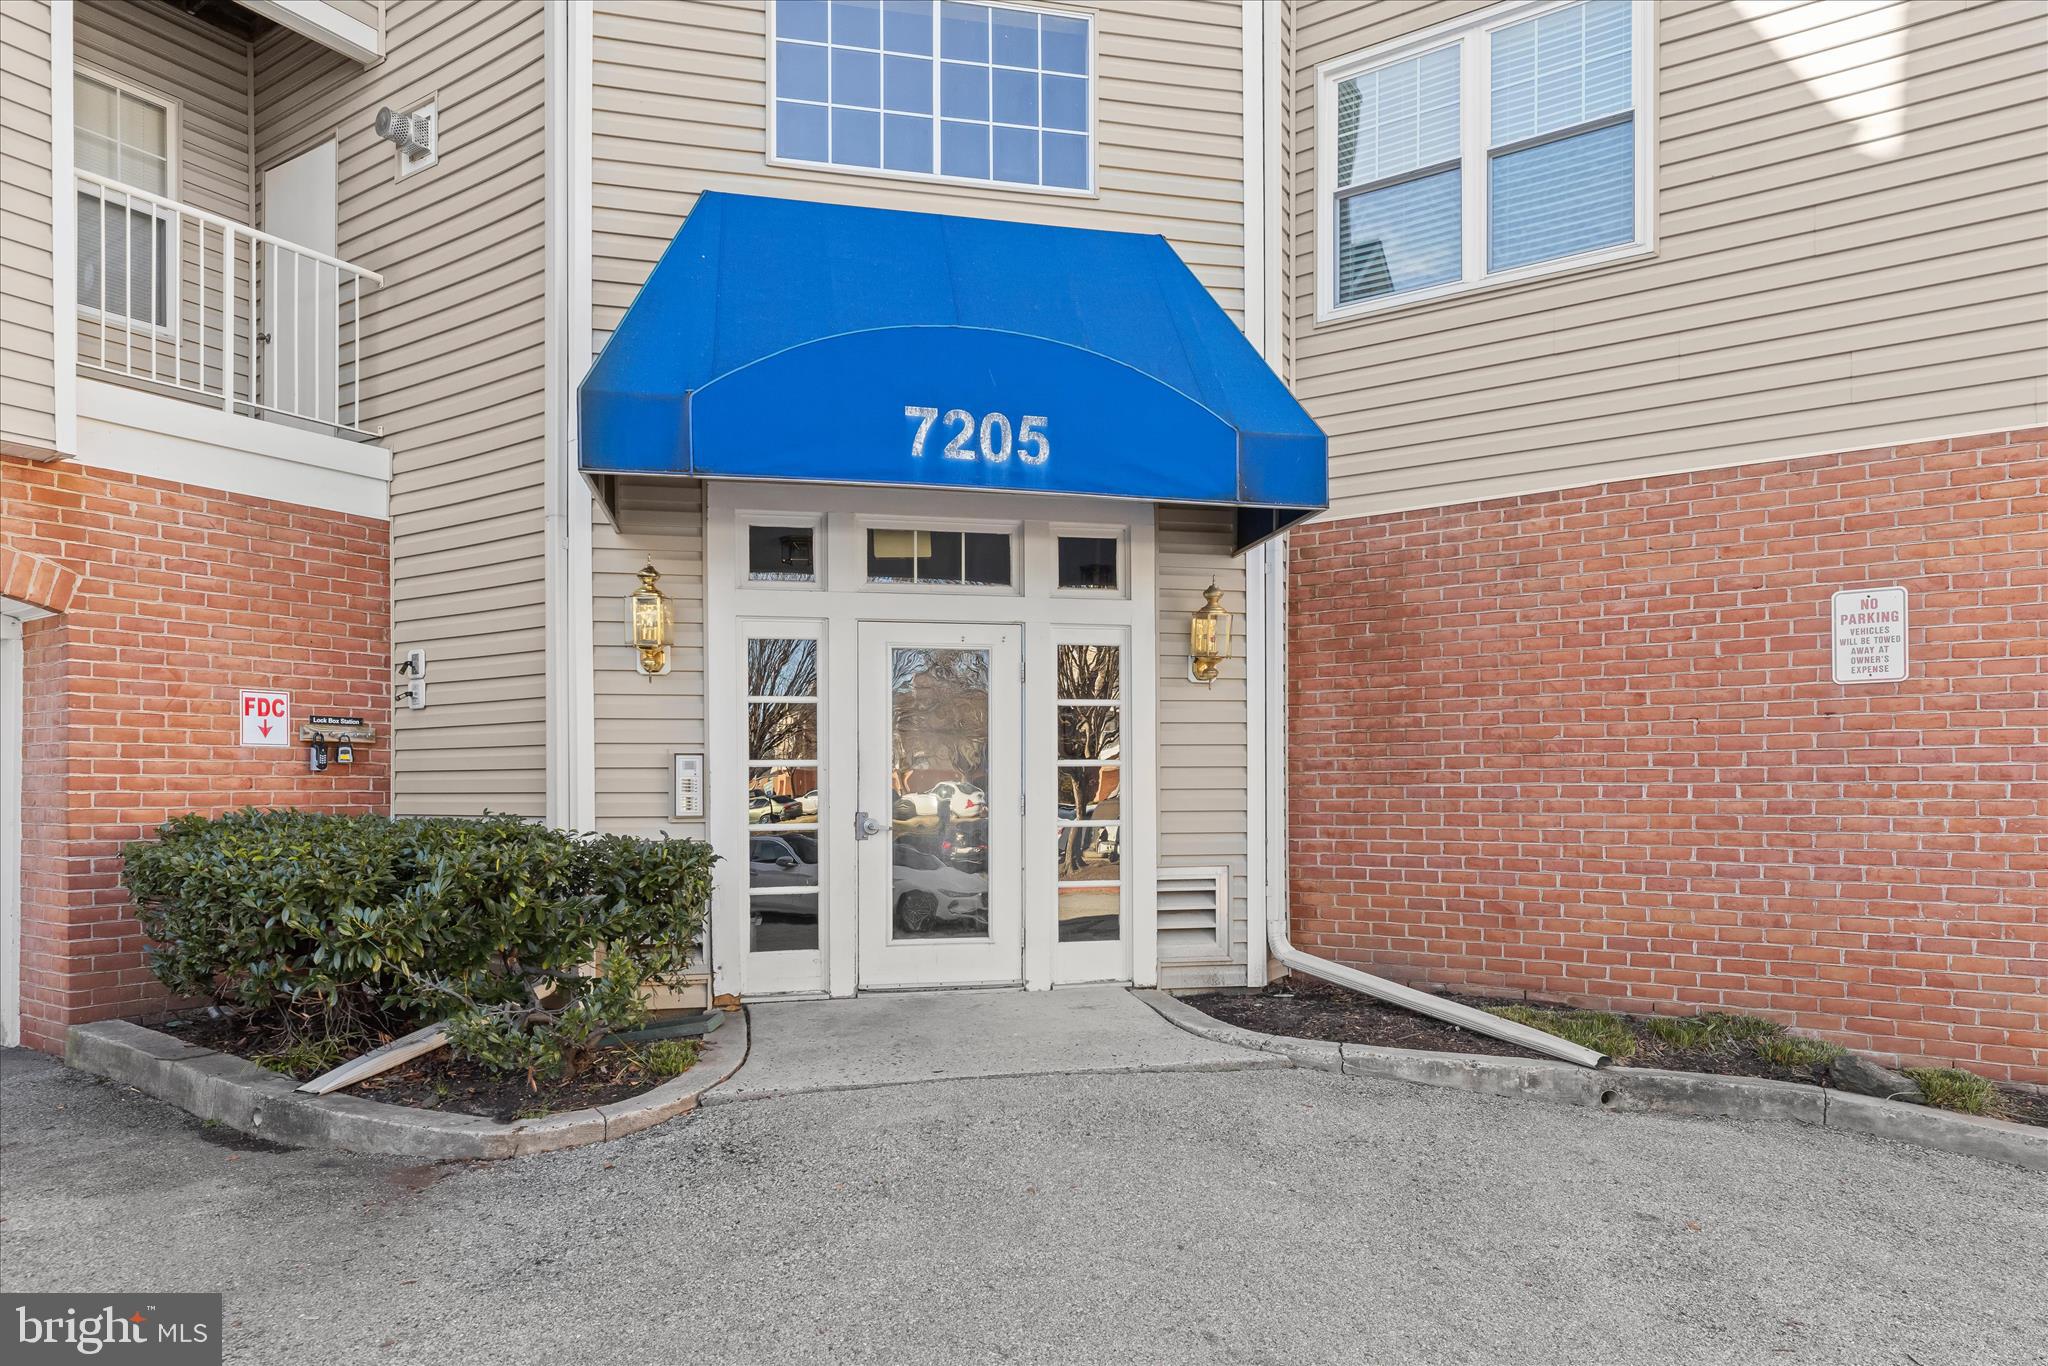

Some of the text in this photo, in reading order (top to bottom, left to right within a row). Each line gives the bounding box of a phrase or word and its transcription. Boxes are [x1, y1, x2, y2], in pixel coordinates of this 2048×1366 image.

[904, 405, 1050, 465] 7205
[1860, 598, 1879, 610] NO
[1841, 611, 1899, 625] PARKING
[1850, 626, 1890, 636] VEHICLES
[1840, 635, 1901, 646] WILL BE TOWED
[1851, 645, 1890, 655] AWAY AT
[1850, 655, 1890, 665] OWNER'S
[1851, 665, 1890, 674] EXPENSE
[244, 697, 286, 717] FDC
